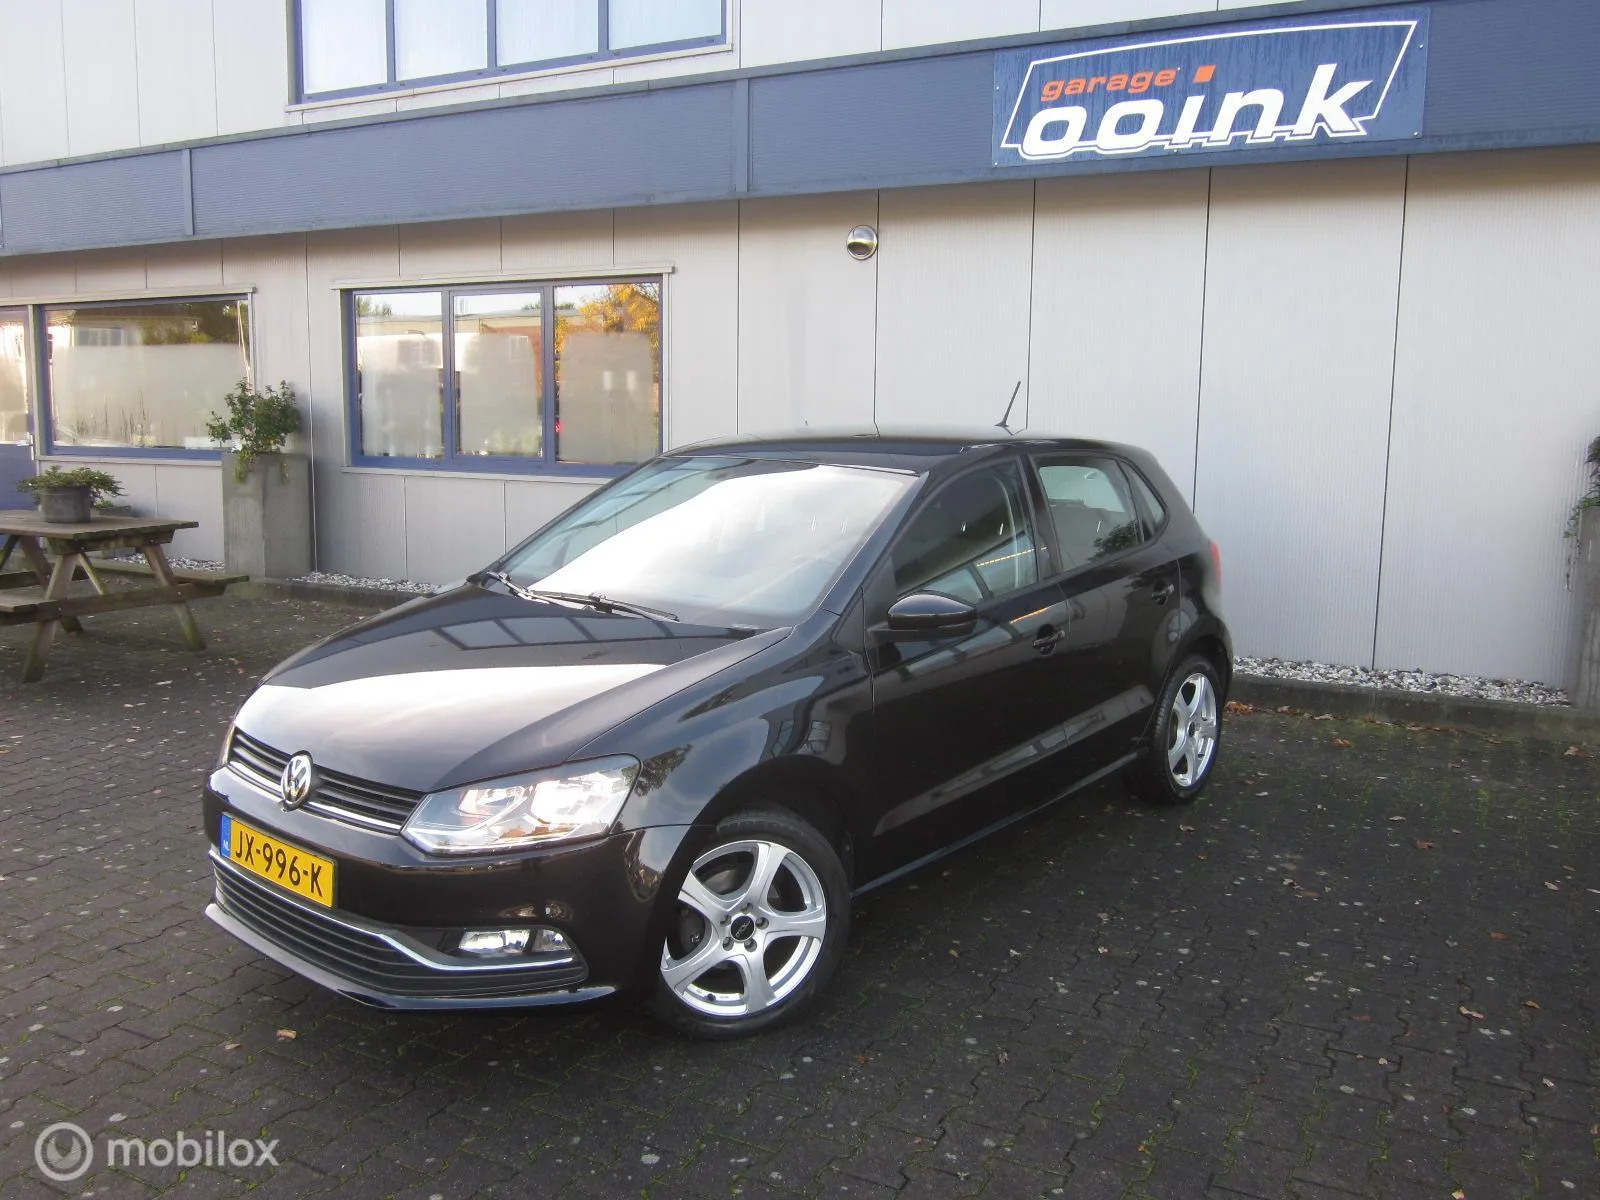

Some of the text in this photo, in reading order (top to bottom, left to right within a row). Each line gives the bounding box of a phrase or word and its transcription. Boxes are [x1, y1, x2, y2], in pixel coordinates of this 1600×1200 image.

[1021, 63, 1374, 156] ooink
[1040, 69, 1178, 102] garage
[235, 830, 324, 898] JX-996-K
